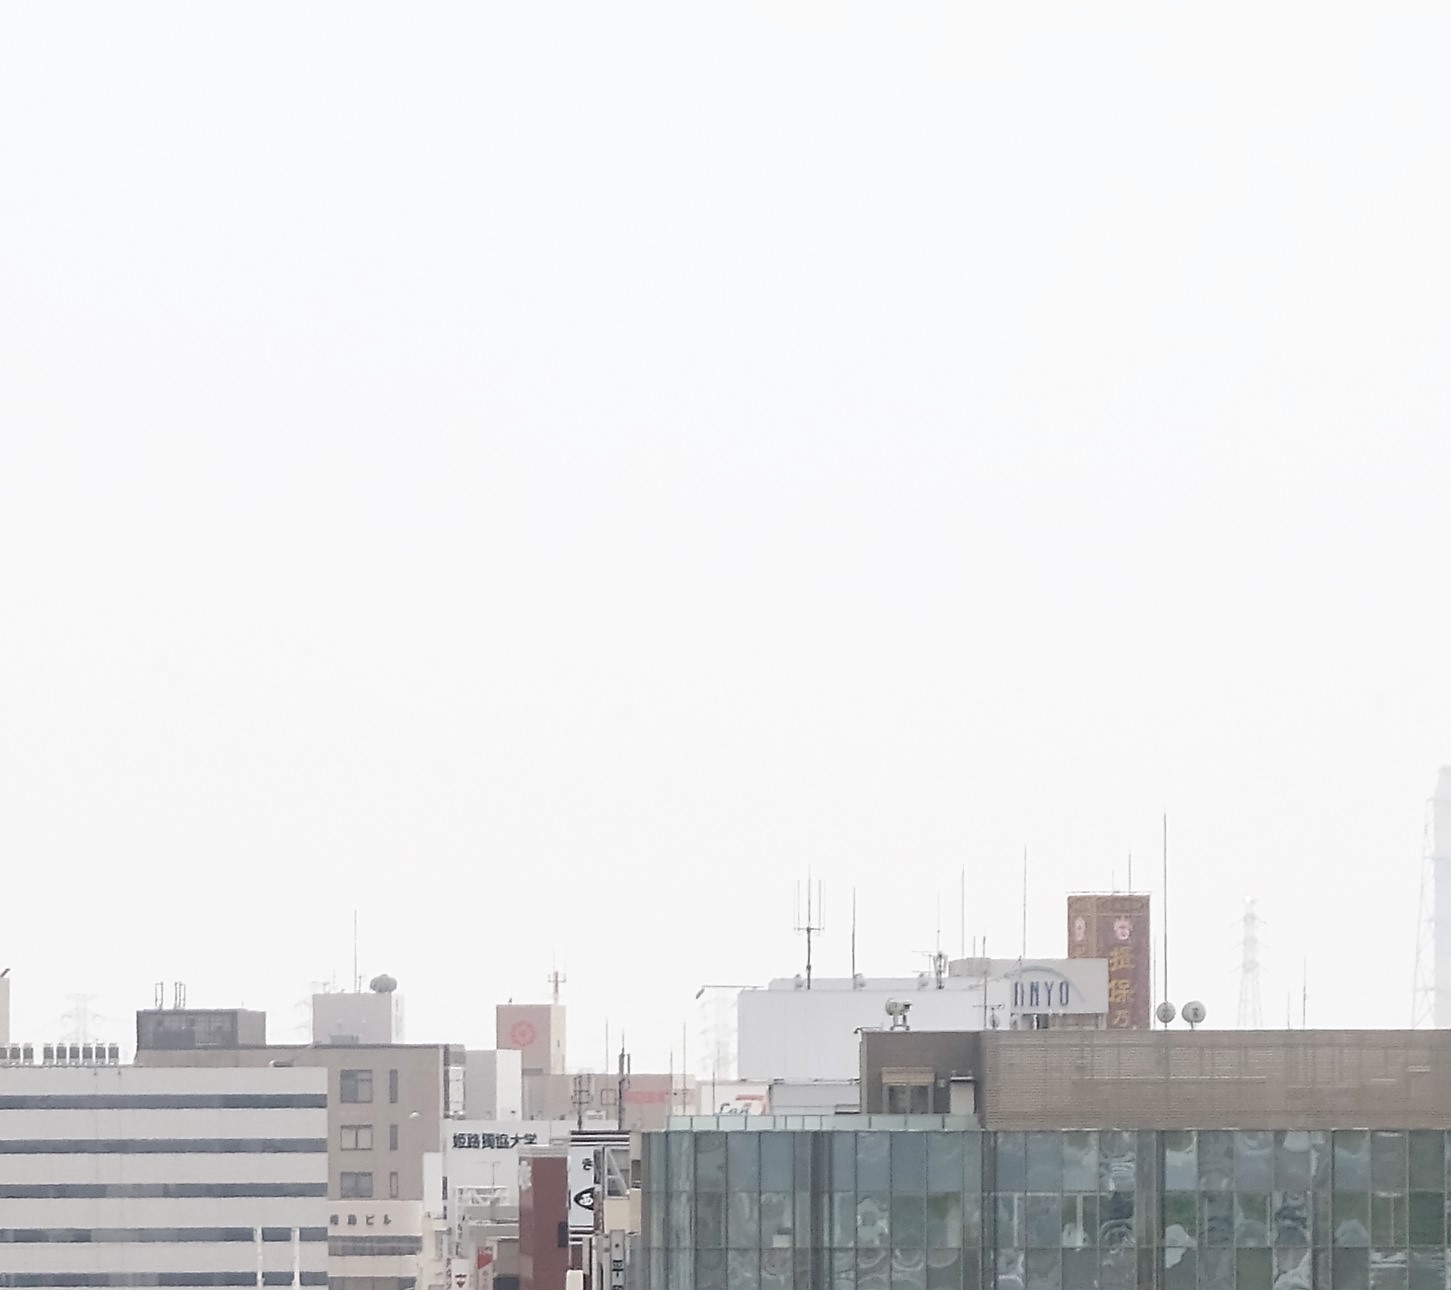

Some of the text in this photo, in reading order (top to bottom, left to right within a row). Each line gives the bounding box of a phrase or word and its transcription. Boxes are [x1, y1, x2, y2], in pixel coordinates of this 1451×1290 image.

[453, 1132, 538, 1149] 姫路獨協大学
